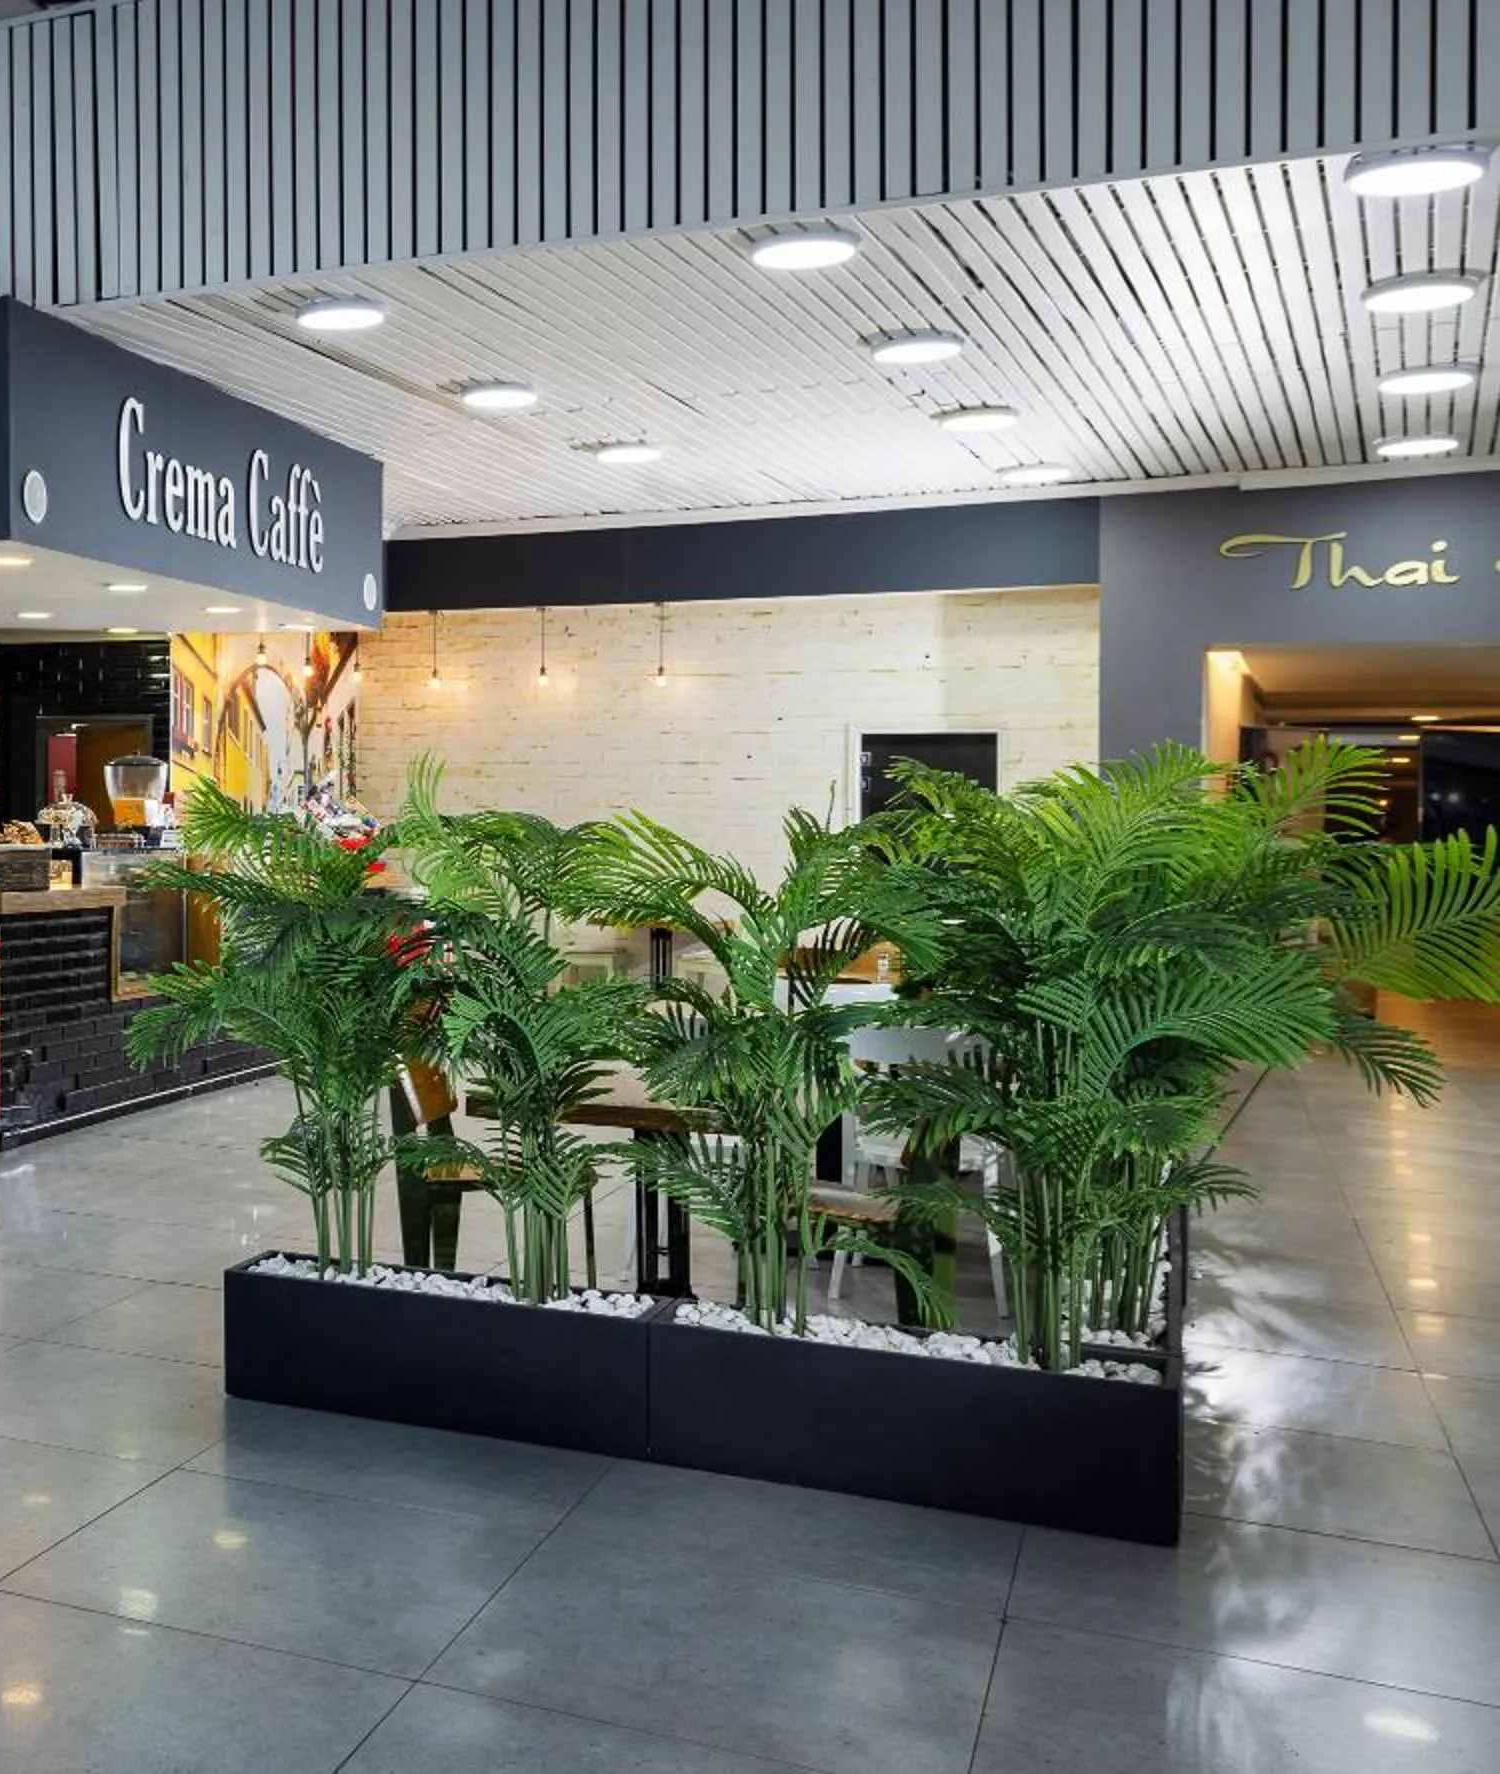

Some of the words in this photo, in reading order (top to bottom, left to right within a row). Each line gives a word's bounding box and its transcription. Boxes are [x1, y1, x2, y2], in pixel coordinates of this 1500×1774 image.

[118, 397, 237, 549] Crema
[249, 449, 324, 573] Caffè
[1219, 531, 1461, 589] Thai
